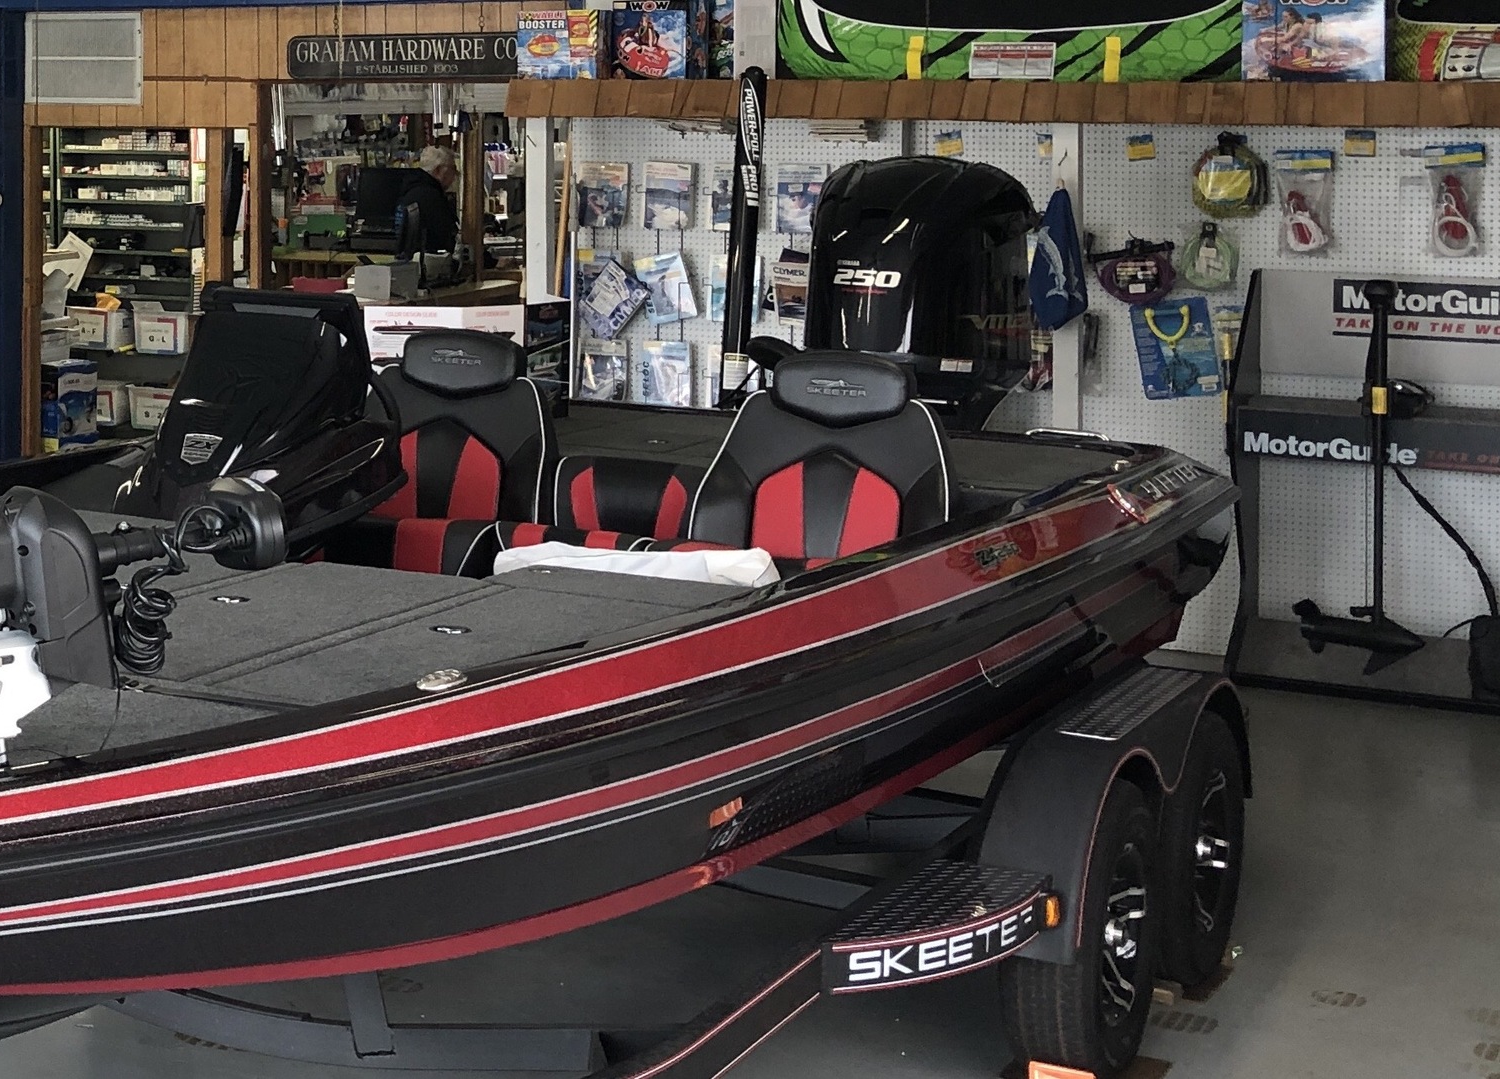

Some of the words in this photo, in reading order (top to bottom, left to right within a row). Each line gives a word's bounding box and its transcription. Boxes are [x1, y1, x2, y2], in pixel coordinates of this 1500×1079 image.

[630, 0, 670, 12] WOW
[519, 20, 565, 29] BOOSTER
[296, 40, 376, 63] GRAHAM
[382, 37, 485, 62] HARDWARE
[356, 65, 428, 74] ESTABLISHED
[433, 64, 459, 74] 1903
[744, 88, 759, 160] POWER-POLE
[741, 165, 750, 190] SERIES
[748, 165, 758, 191] PRO
[772, 266, 807, 277] CLYMER
[833, 268, 902, 288] 250
[1342, 285, 1500, 316] MtorGui
[1336, 318, 1370, 328] TAK
[1393, 321, 1419, 331] ON
[1430, 322, 1465, 334] THE
[430, 356, 482, 366] SKEETER
[806, 386, 866, 397] SKEETER
[185, 440, 218, 450] ZX
[1243, 431, 1417, 465] MotorGude
[849, 906, 1033, 982] SKEETER
